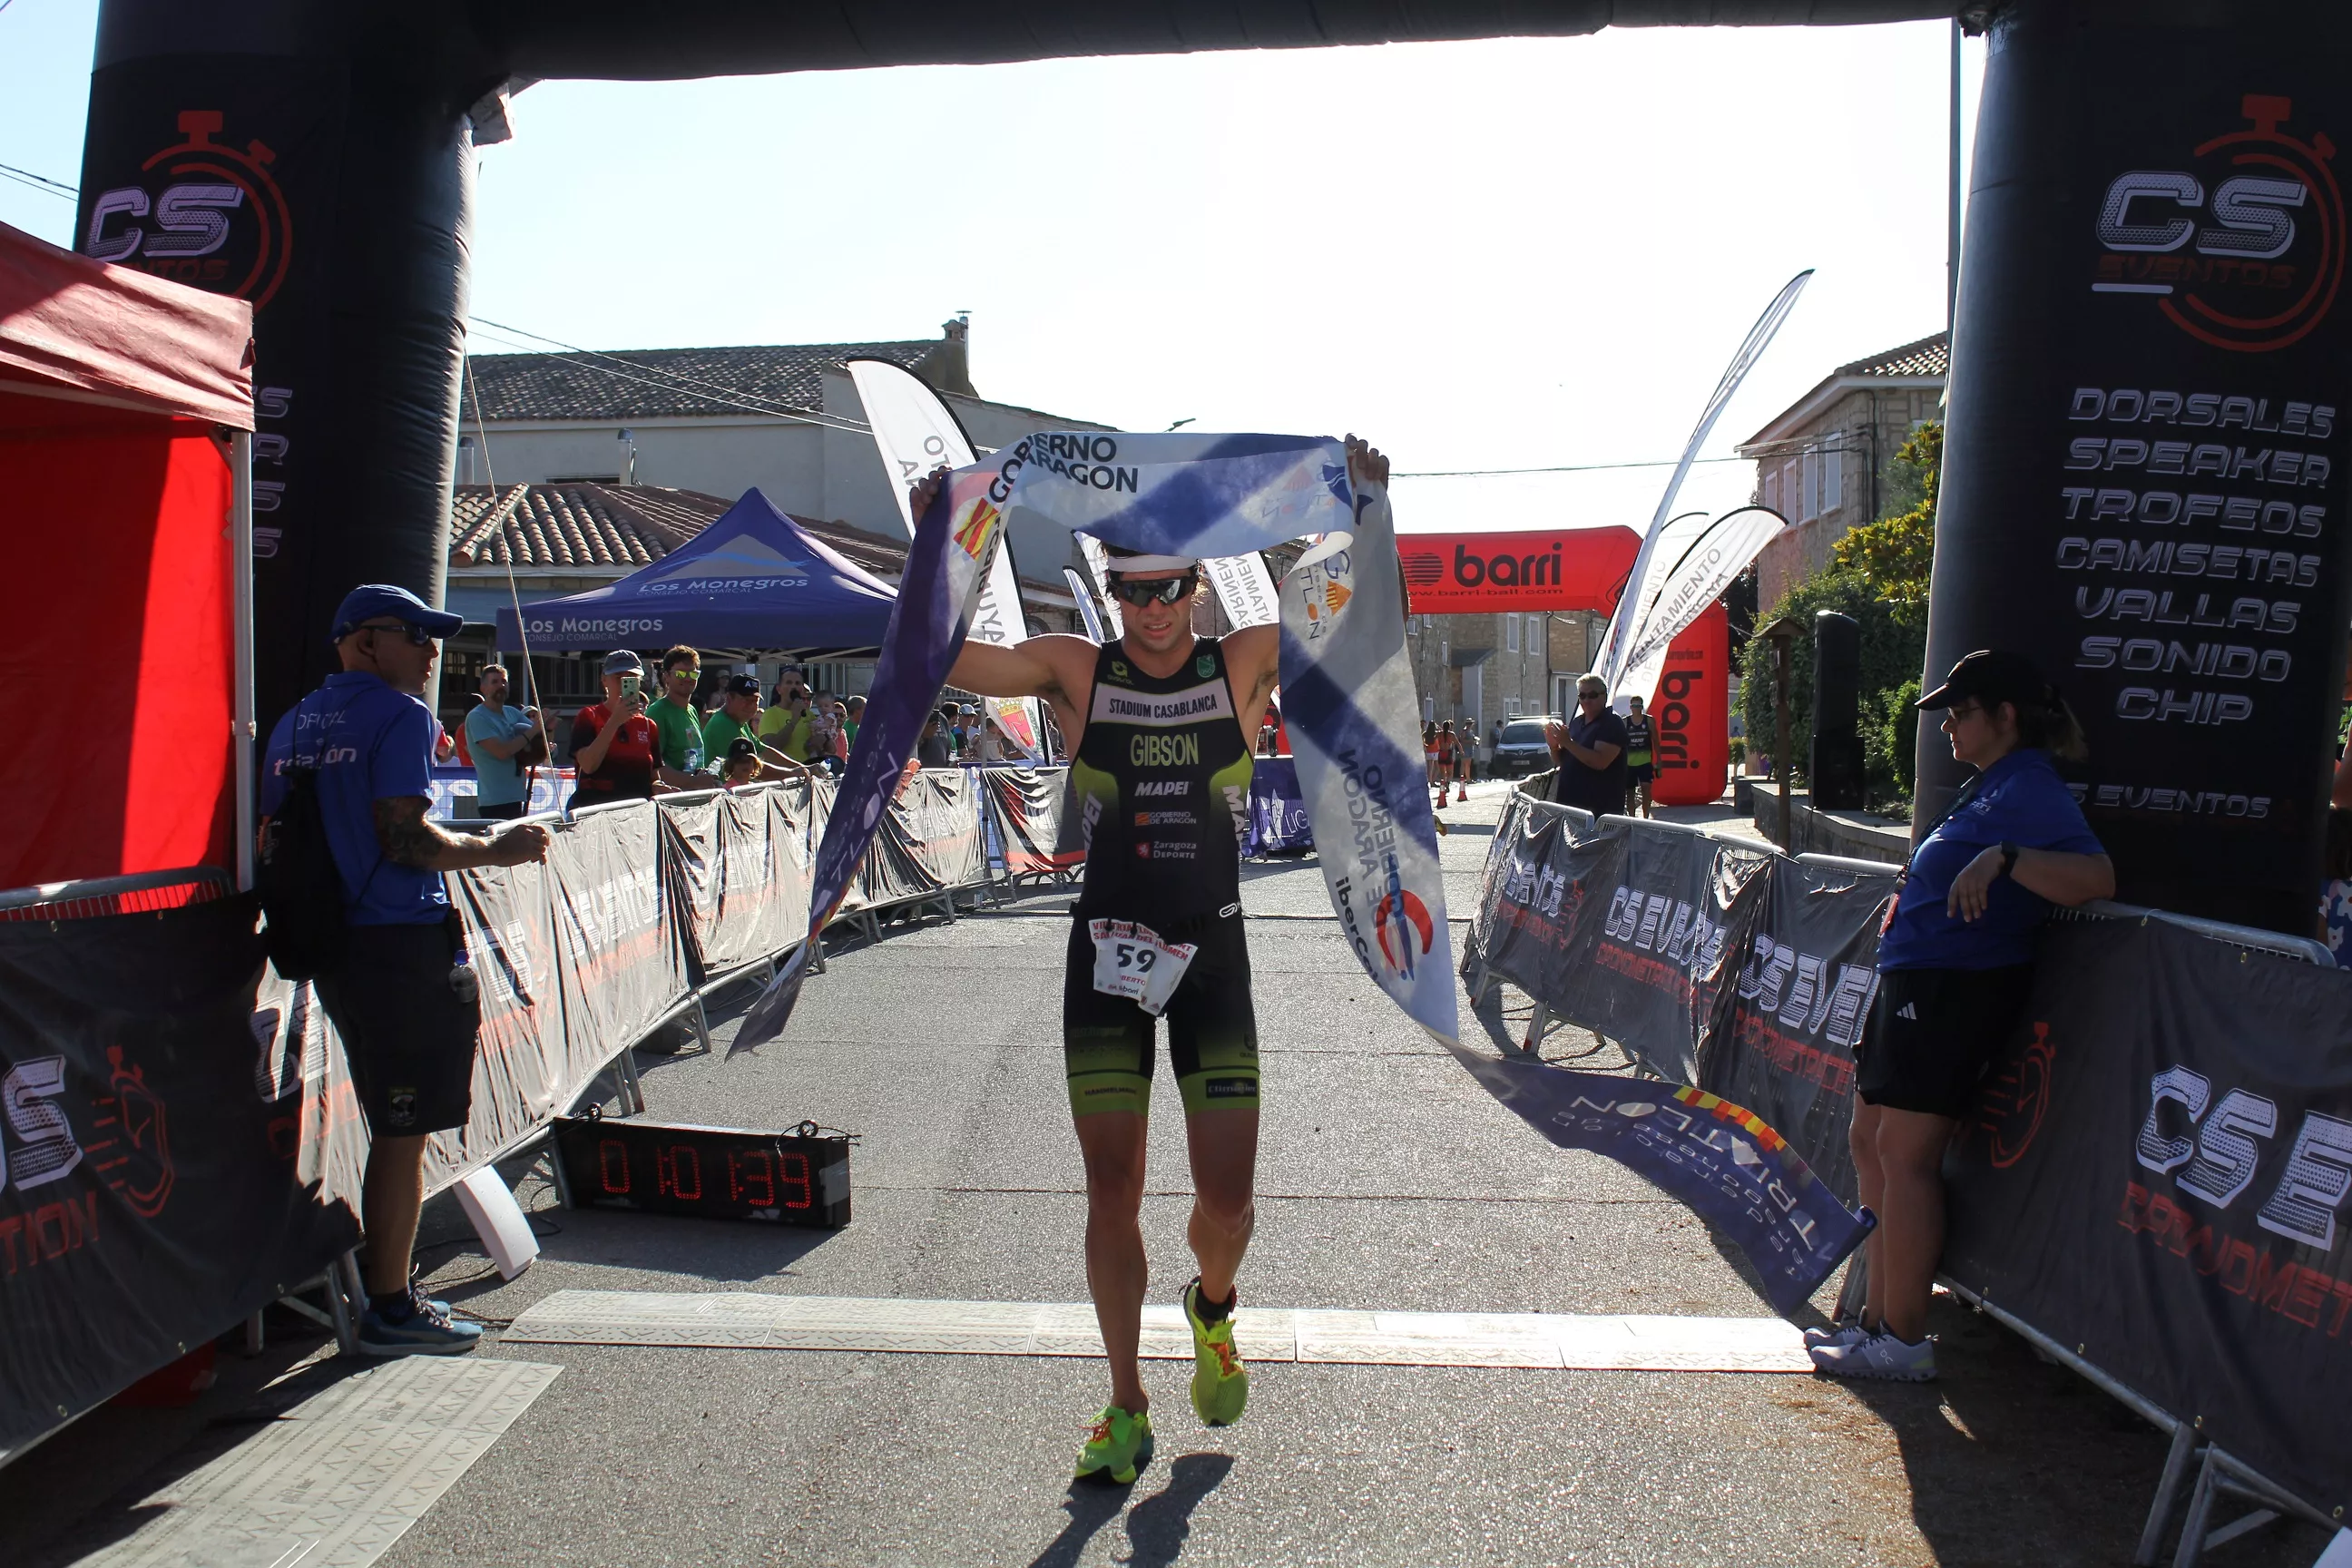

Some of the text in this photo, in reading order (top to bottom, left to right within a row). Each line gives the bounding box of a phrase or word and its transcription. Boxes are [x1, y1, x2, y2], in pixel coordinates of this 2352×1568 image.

[86, 183, 246, 261] CS
[2096, 170, 2307, 258] CS
[2096, 254, 2296, 288] EVENTOS
[2069, 387, 2336, 438] DORSALES
[2063, 437, 2330, 488] SPEAKER
[2061, 486, 2326, 538] TROFEOS
[1454, 542, 1563, 587] barri
[2055, 537, 2321, 587] CAMISETAS
[639, 579, 808, 593] Los Monegros
[523, 618, 663, 635] Los Monegros
[2075, 586, 2300, 634] VALLAS
[526, 634, 564, 642] ONSEJO
[2074, 635, 2291, 682] SONIDO
[1109, 694, 1218, 719] STADIUM CASABLANCA
[1660, 670, 1703, 769] barri
[2115, 687, 2252, 725] CHIP
[1130, 731, 1200, 767] GIBSON
[1134, 781, 1190, 797] MAPEI
[2094, 784, 2271, 818] EVENTOS
[1153, 840, 1197, 850] Zaragoza
[1116, 943, 1157, 974] 59
[1739, 933, 1796, 1012] CS
[2135, 1063, 2278, 1210] CS
